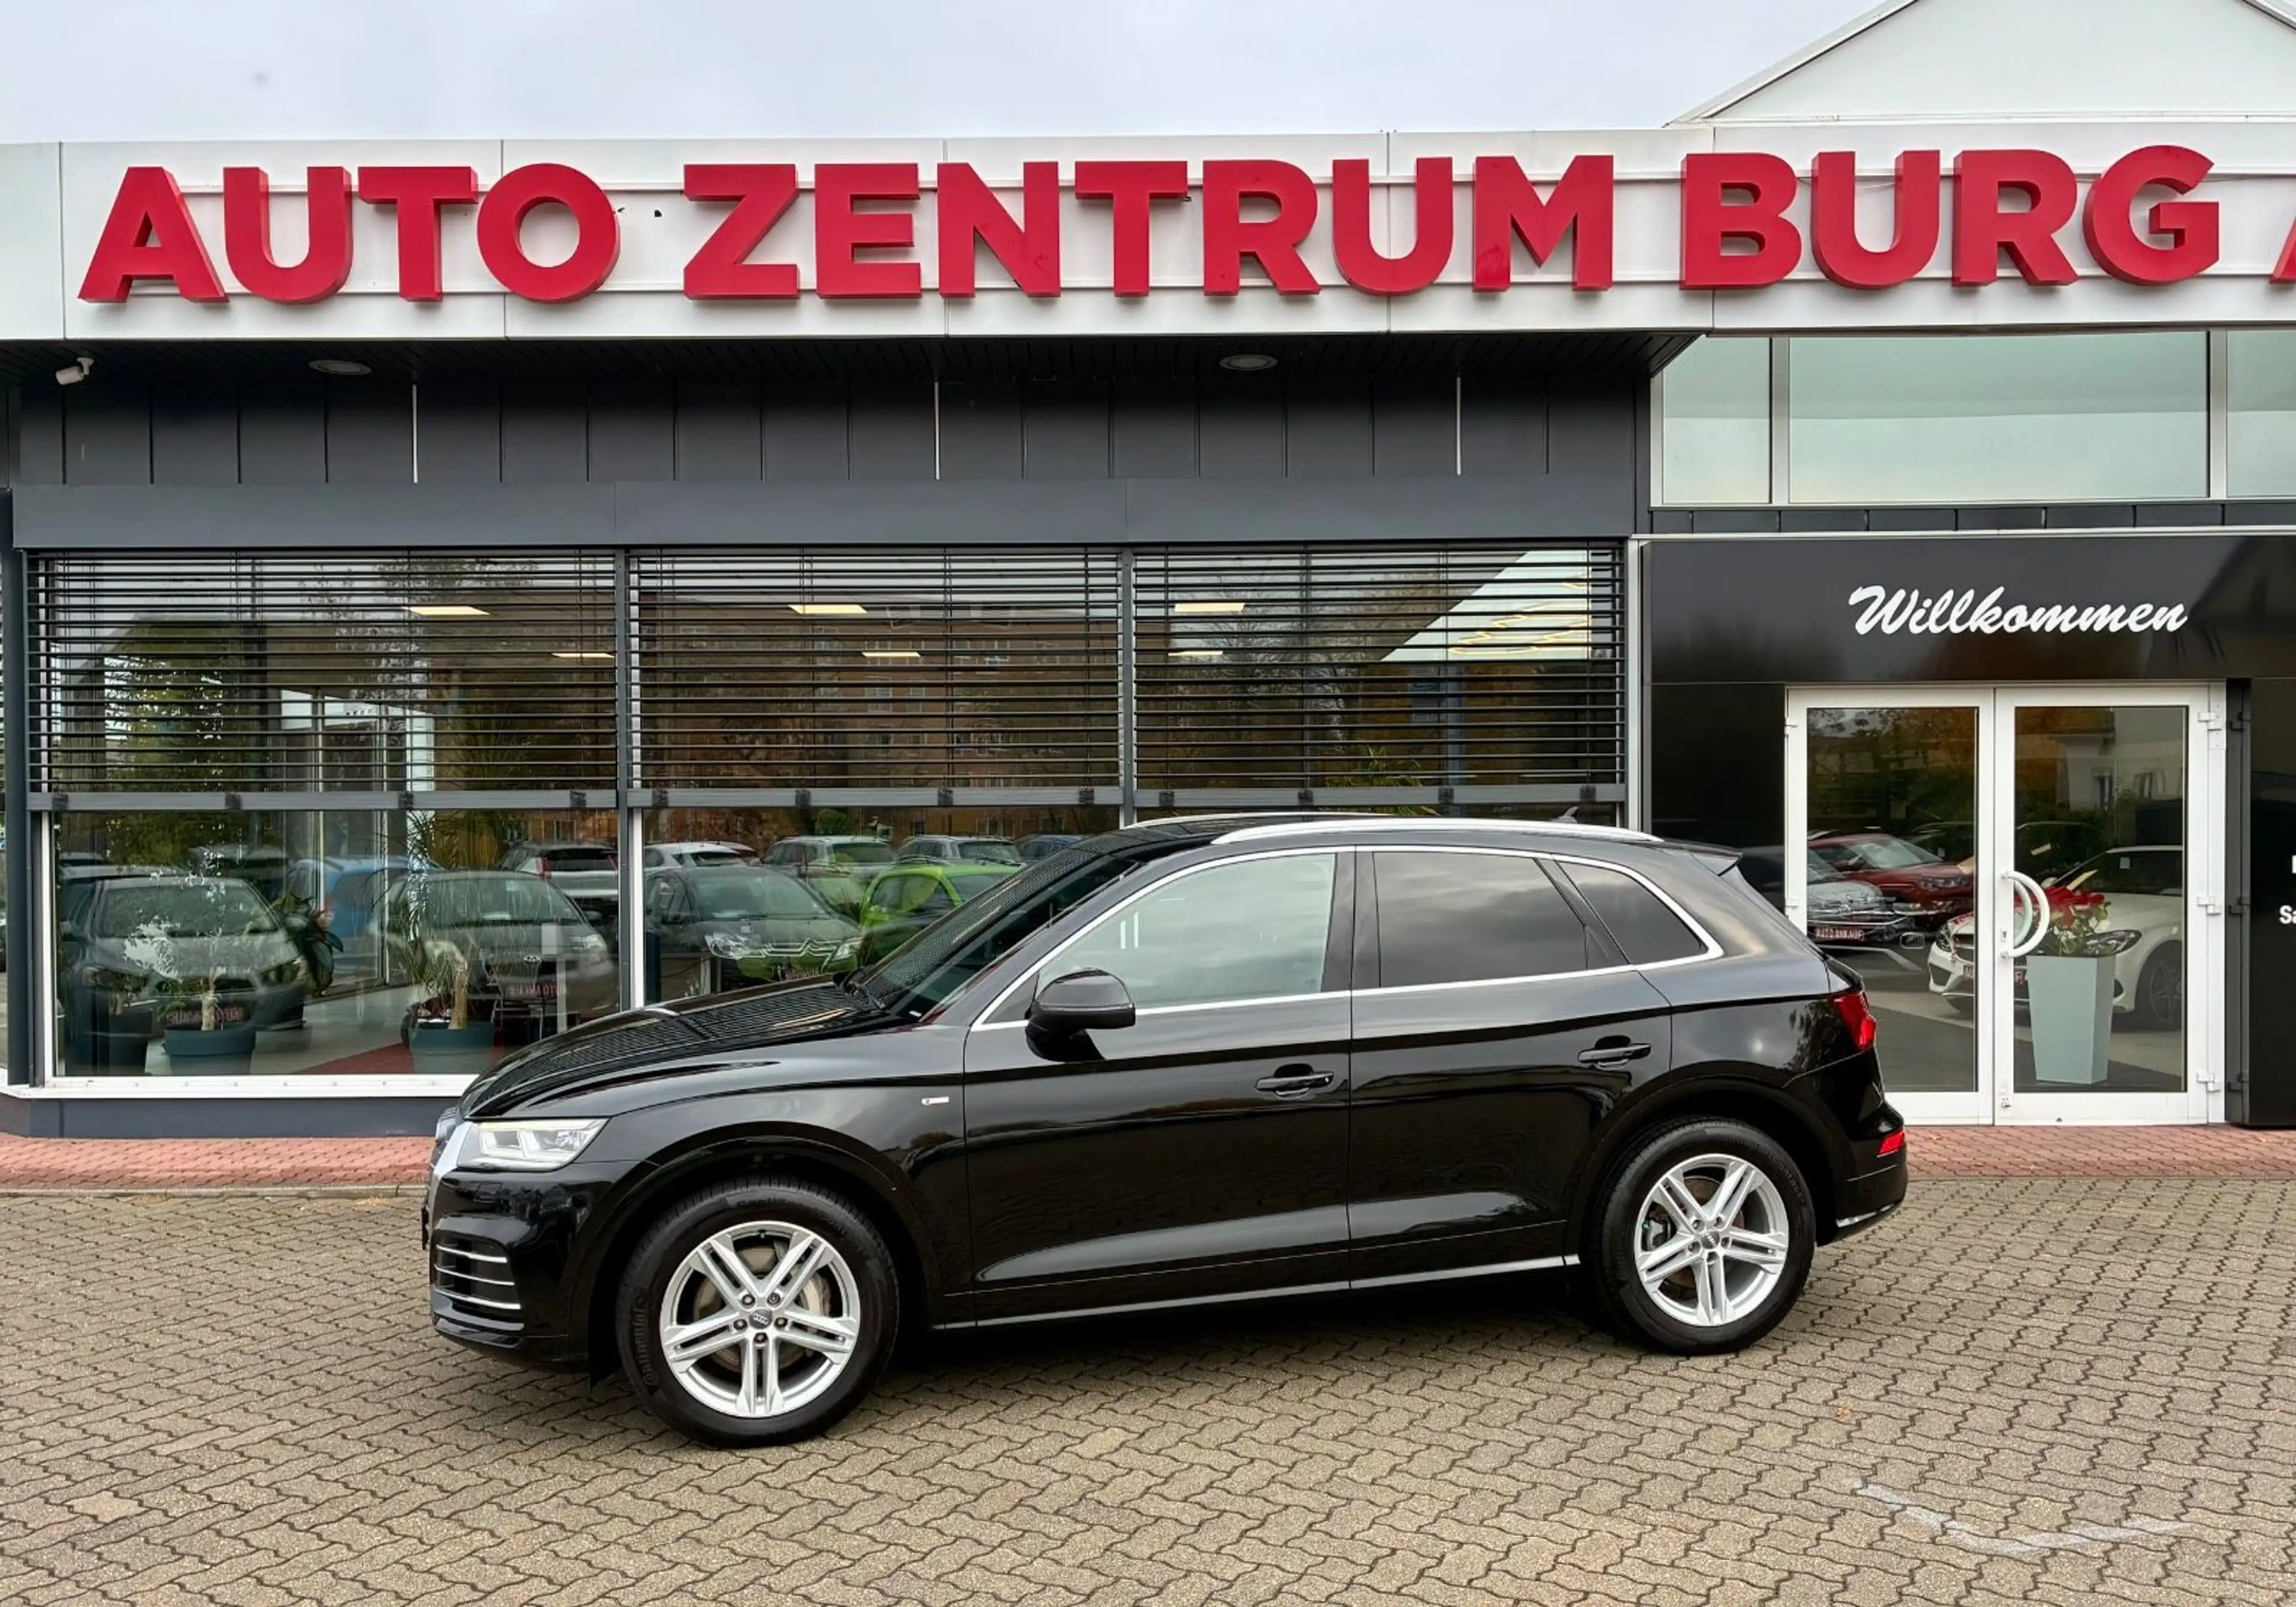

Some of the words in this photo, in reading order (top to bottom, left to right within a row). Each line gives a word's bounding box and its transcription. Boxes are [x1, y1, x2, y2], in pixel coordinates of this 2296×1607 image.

[77, 163, 620, 304] AUTO
[683, 155, 1614, 299] ZENTRUM
[1680, 145, 2220, 291] BURG
[1848, 585, 2188, 635] Willkommen
